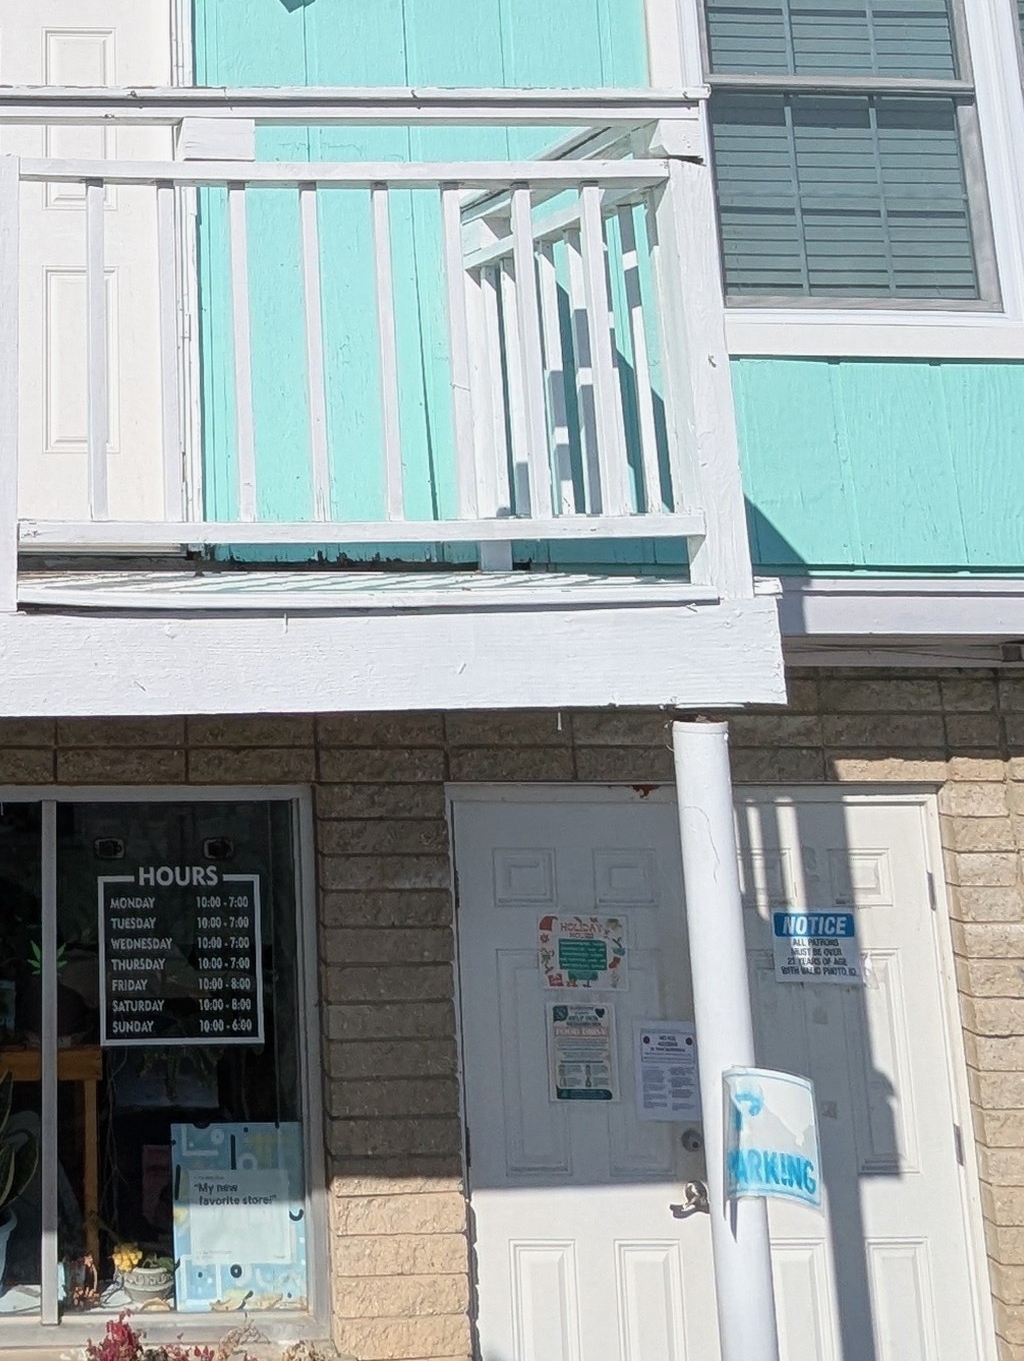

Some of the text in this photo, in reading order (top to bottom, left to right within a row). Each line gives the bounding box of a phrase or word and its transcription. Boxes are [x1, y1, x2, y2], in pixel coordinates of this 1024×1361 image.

[139, 865, 218, 886] HOURS
[110, 897, 156, 909] MONDAY
[196, 896, 221, 908] 10:00
[228, 896, 249, 908] 7:00
[111, 917, 156, 929] TUESDAY
[197, 917, 222, 929] 10:00
[229, 917, 249, 928] 7:00
[782, 916, 848, 935] NOTICE
[110, 938, 173, 950] WEDNESDAY
[197, 937, 222, 949] 10:00
[229, 937, 250, 949] 7:00
[792, 938, 840, 947] ALL PATRONS
[791, 947, 842, 956] MUST BE OVER
[111, 958, 166, 971] THURSDAY
[198, 957, 223, 969] 10:00
[230, 957, 250, 969] 7:00
[787, 957, 847, 966] 21 YEARS OF AGE
[781, 966, 800, 975] WITH
[801, 966, 821, 975] VALID
[112, 979, 148, 992] FRIDAY
[198, 978, 223, 990] 10:00
[231, 977, 251, 989] 8:00
[112, 999, 165, 1012] SATURDAY
[199, 999, 224, 1011] 10:00
[231, 999, 252, 1010] 8:00
[112, 1020, 154, 1034] SUNDAY
[199, 1019, 224, 1033] 10:00
[232, 1019, 253, 1031] 6:00
[216, 1184, 238, 1192] new
[199, 1195, 240, 1206] favorite
